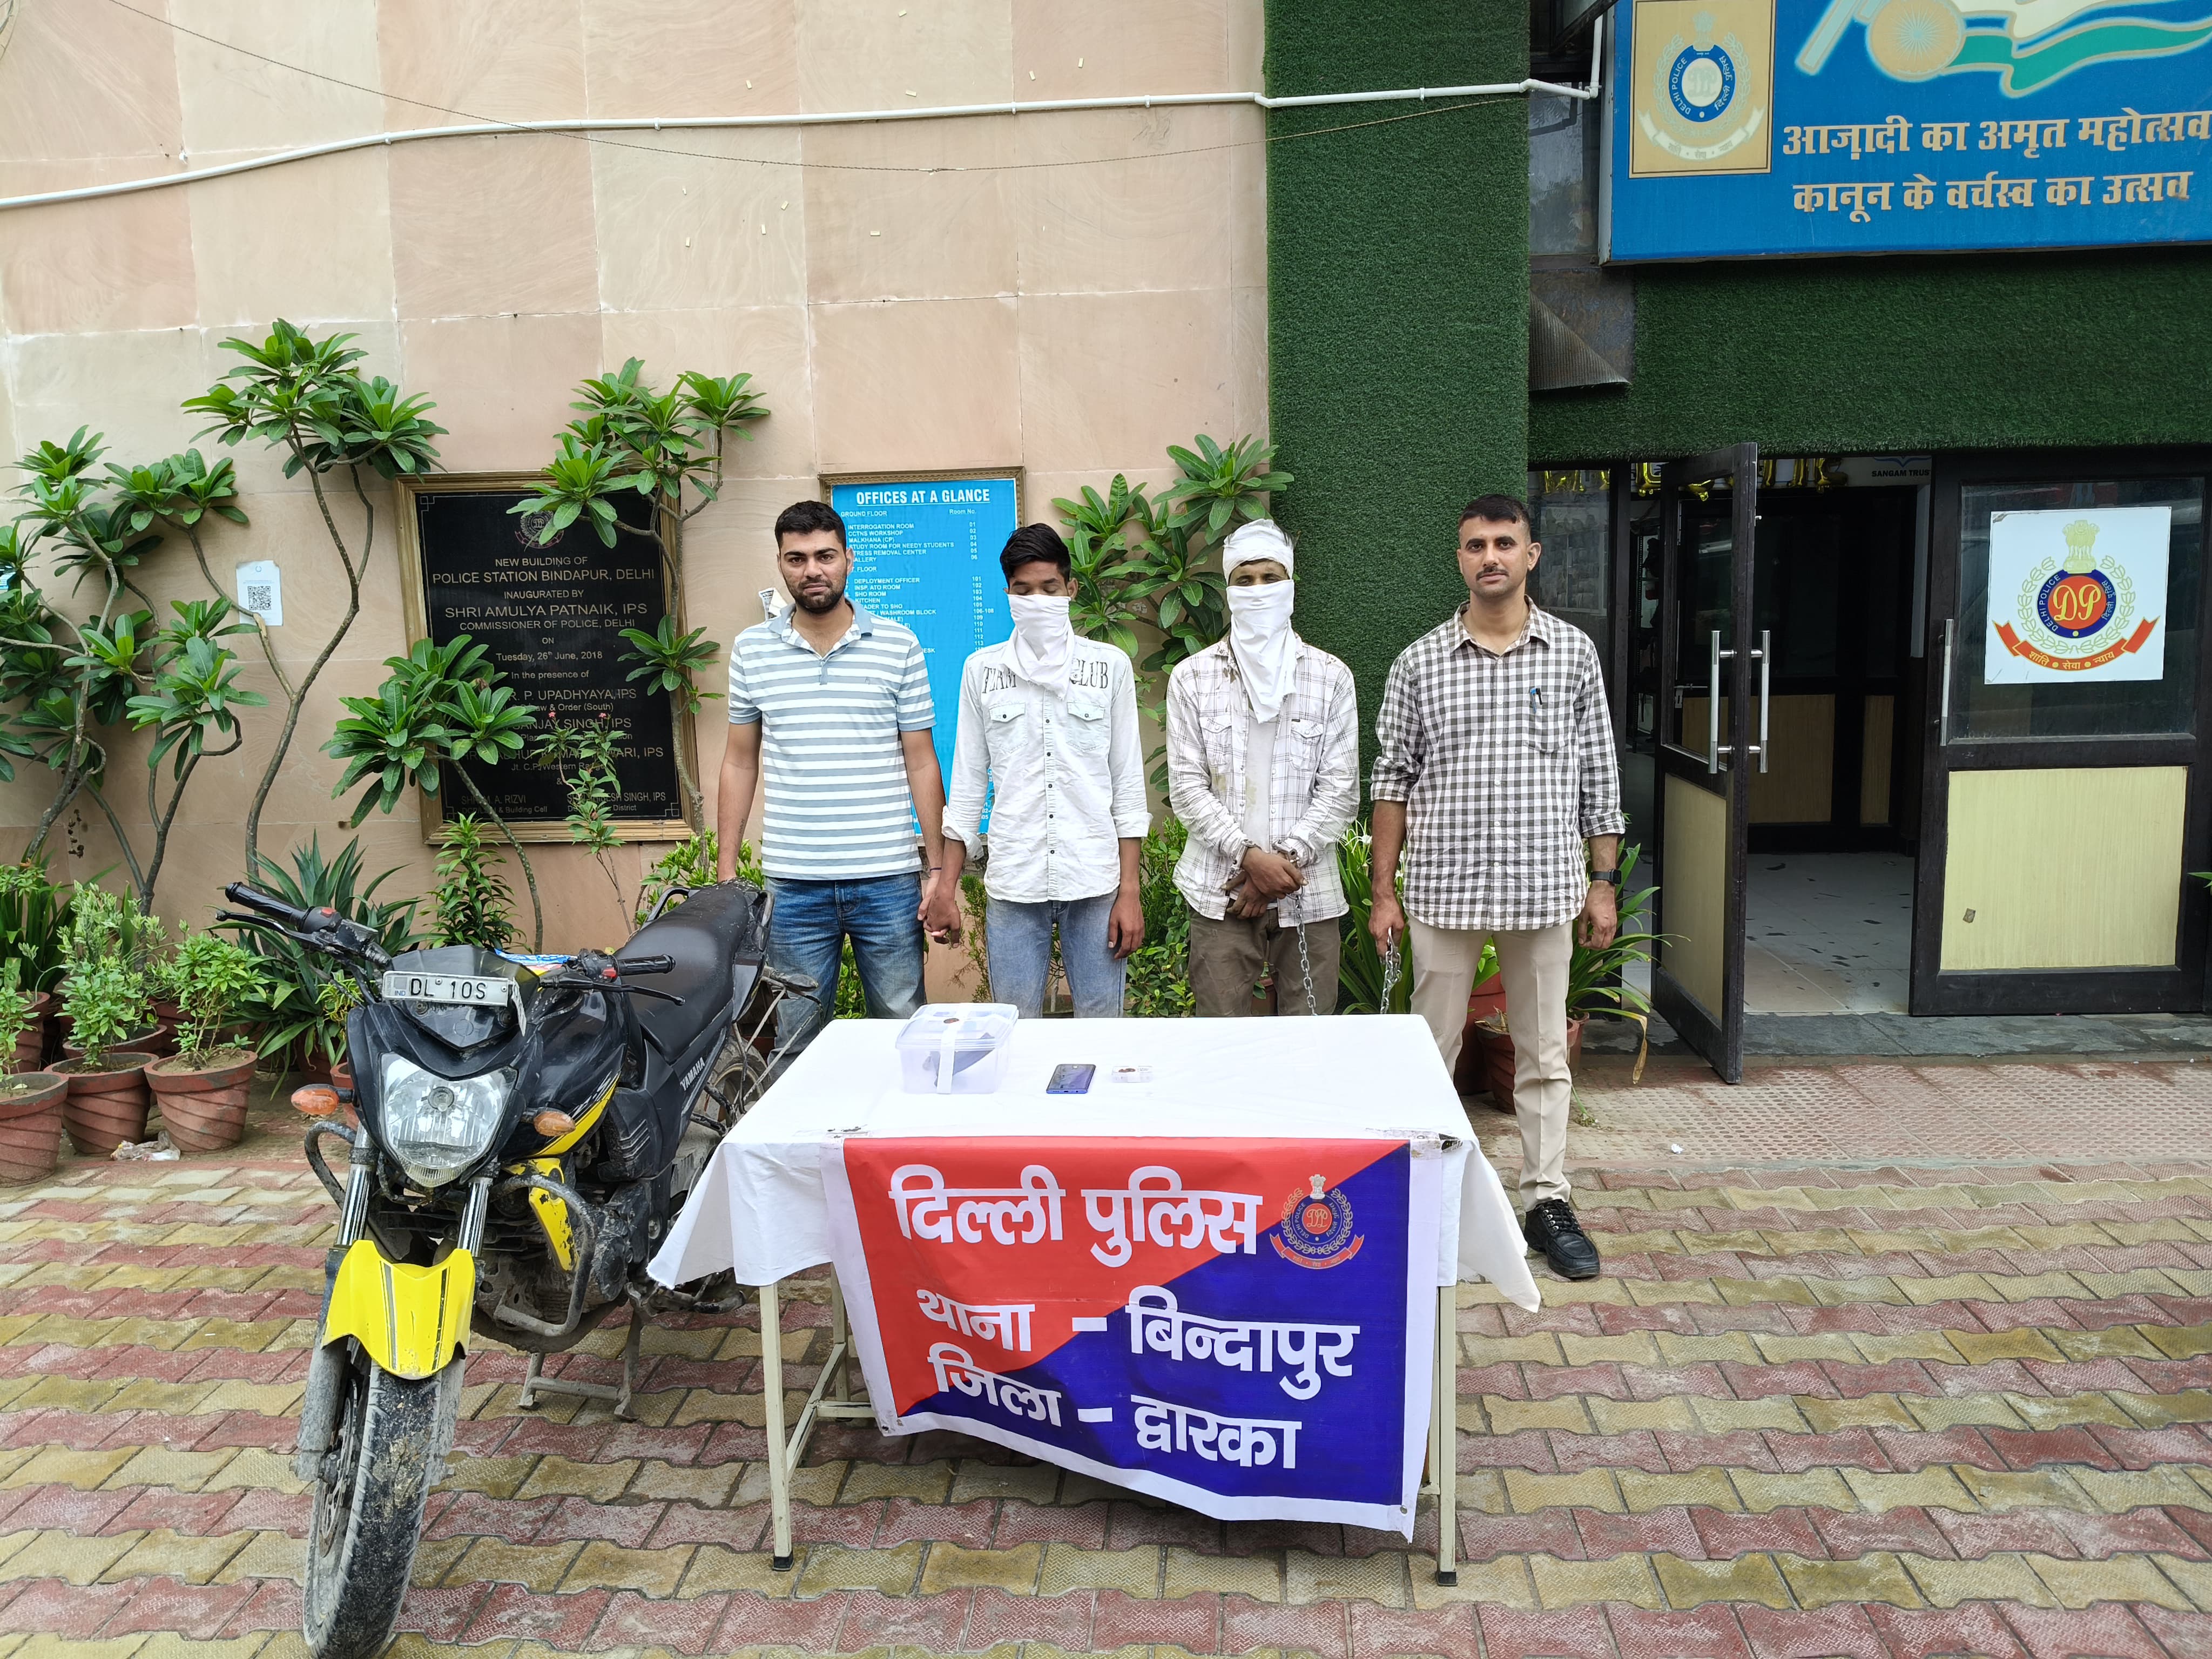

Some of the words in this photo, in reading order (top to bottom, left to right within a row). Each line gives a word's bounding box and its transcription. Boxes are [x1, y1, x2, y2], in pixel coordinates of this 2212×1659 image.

[1672, 57, 1687, 90] POLICE
[1673, 91, 1691, 115] DELHI
[1783, 115, 1913, 160] आज़ादी
[1921, 123, 1971, 151] का
[1978, 119, 2069, 159] अमृत
[2078, 107, 2212, 151] महोत्सव
[1792, 183, 1894, 223] कानून
[1903, 173, 1936, 210] के
[1945, 171, 2037, 208] वर्चस्व
[2046, 176, 2094, 206] का
[2102, 171, 2194, 204] उत्सव
[857, 491, 907, 504] OFFICES
[912, 491, 925, 503] AT
[930, 490, 938, 502] A
[942, 489, 990, 502] GLANCE
[496, 558, 519, 567] NEW
[522, 557, 571, 566] BUILDING
[574, 557, 588, 565] OF
[433, 572, 480, 583] POLICE
[484, 571, 537, 583] STATION
[542, 570, 612, 582] BINDAPUR,
[617, 569, 655, 579] DELHI
[504, 590, 569, 599] INAUGURATED
[571, 590, 584, 598] BY
[2039, 574, 2061, 605] POLICE
[445, 607, 481, 618] SHRI
[485, 605, 546, 617] AMULYA
[550, 604, 617, 616] PATNAIK,
[623, 603, 648, 614] IPS
[460, 621, 541, 630] COMMISSIONER
[544, 621, 557, 629] OF
[561, 620, 602, 629] POLICE,
[605, 619, 635, 627] DELHI
[2040, 608, 2058, 631] DELHI
[496, 653, 535, 662] Tuesday,
[537, 652, 553, 660] 26th
[555, 652, 578, 660] June,
[2028, 651, 2050, 666] शांति
[2062, 660, 2081, 670] सेवा
[2093, 651, 2115, 664] न्याय
[538, 671, 578, 680] presence
[524, 691, 534, 700] P.
[538, 690, 616, 700] UPADHYAYA,
[583, 703, 613, 712] (South)
[612, 718, 631, 727] IPS
[644, 747, 664, 757] IPS
[504, 794, 526, 804] RIZVI
[624, 792, 651, 802] SINGH,
[653, 792, 666, 801] IPS
[505, 806, 532, 814] Building
[410, 978, 434, 997] DL
[680, 1057, 705, 1091] YAMAHA
[888, 1164, 1066, 1245] दिल्ली
[1081, 1165, 1263, 1267] पुलिस
[1295, 1202, 1306, 1223] POLICE
[1296, 1223, 1310, 1239] DELHI
[916, 1288, 1036, 1352] थाना
[1125, 1285, 1361, 1401] बिन्दापुर
[927, 1341, 1062, 1427] जिला
[1131, 1394, 1303, 1470] द्वारका
